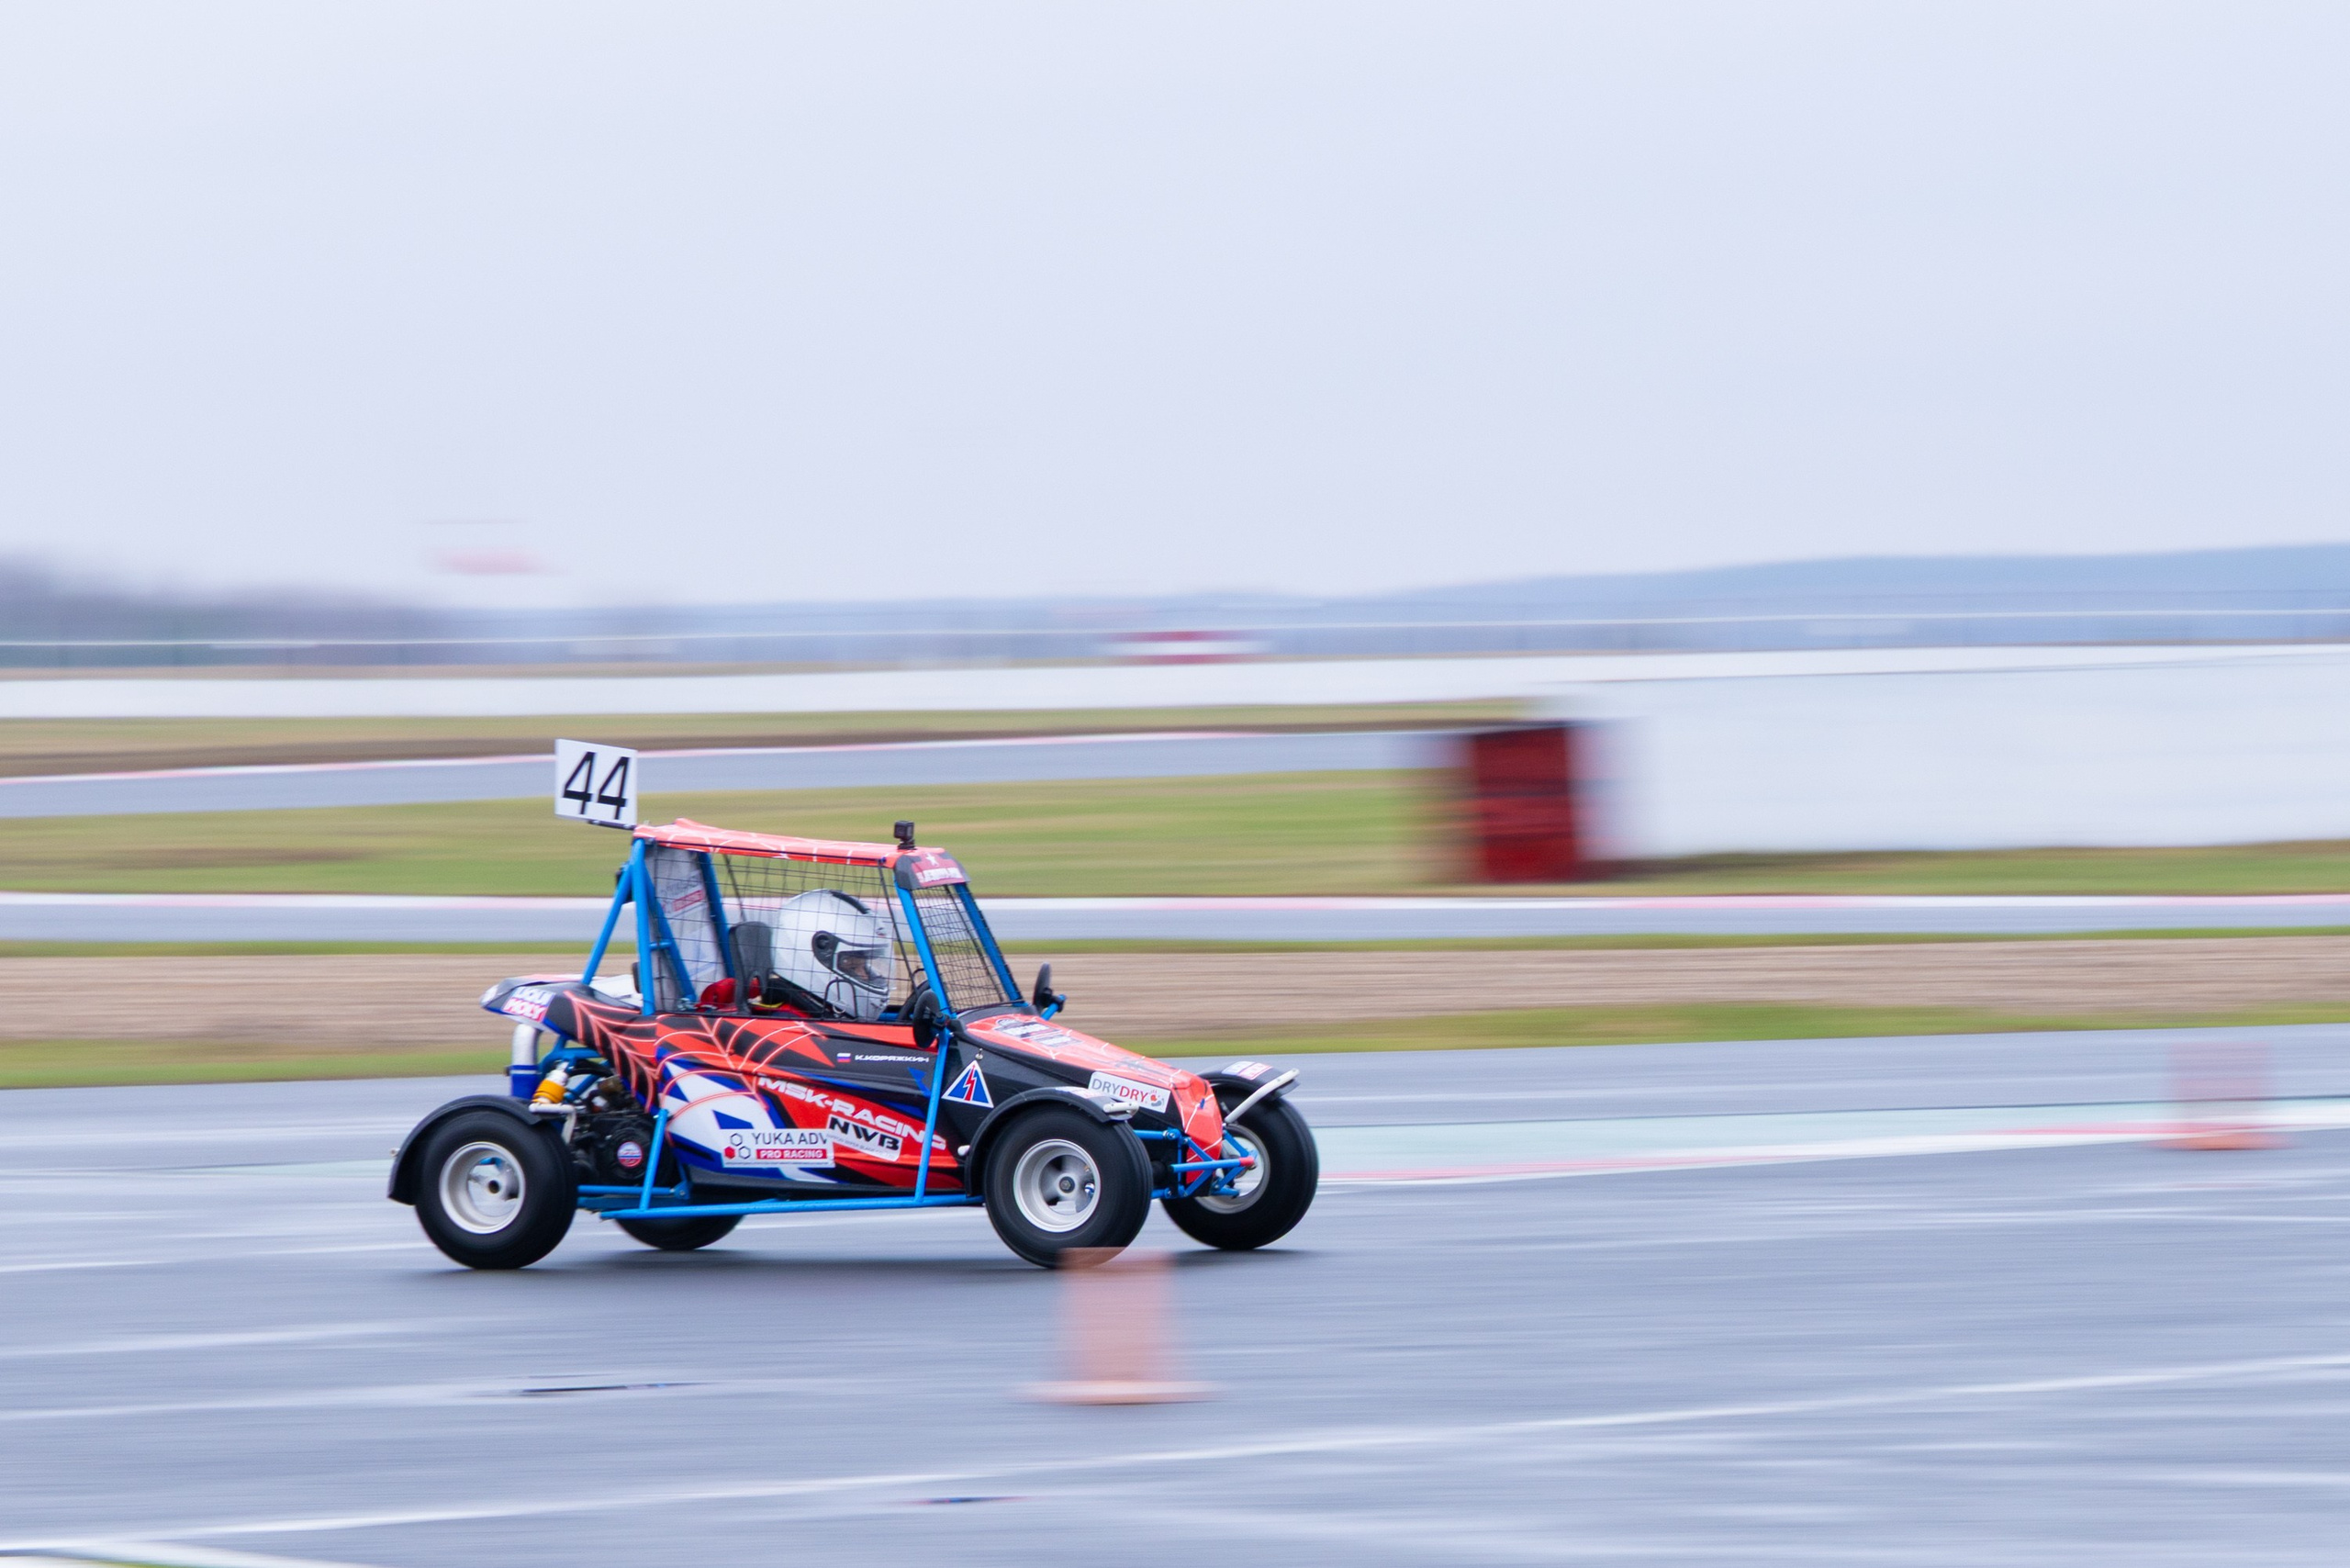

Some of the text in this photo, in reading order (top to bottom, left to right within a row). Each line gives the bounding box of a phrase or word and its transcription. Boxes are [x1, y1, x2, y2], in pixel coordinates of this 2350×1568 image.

[562, 751, 631, 820] 44
[1091, 1079, 1148, 1103] DRYDRY
[758, 1073, 946, 1150] MSK-RACING
[751, 1132, 795, 1145] YUKA
[829, 1116, 900, 1150] NWB
[759, 1149, 823, 1159] PRO RACING
